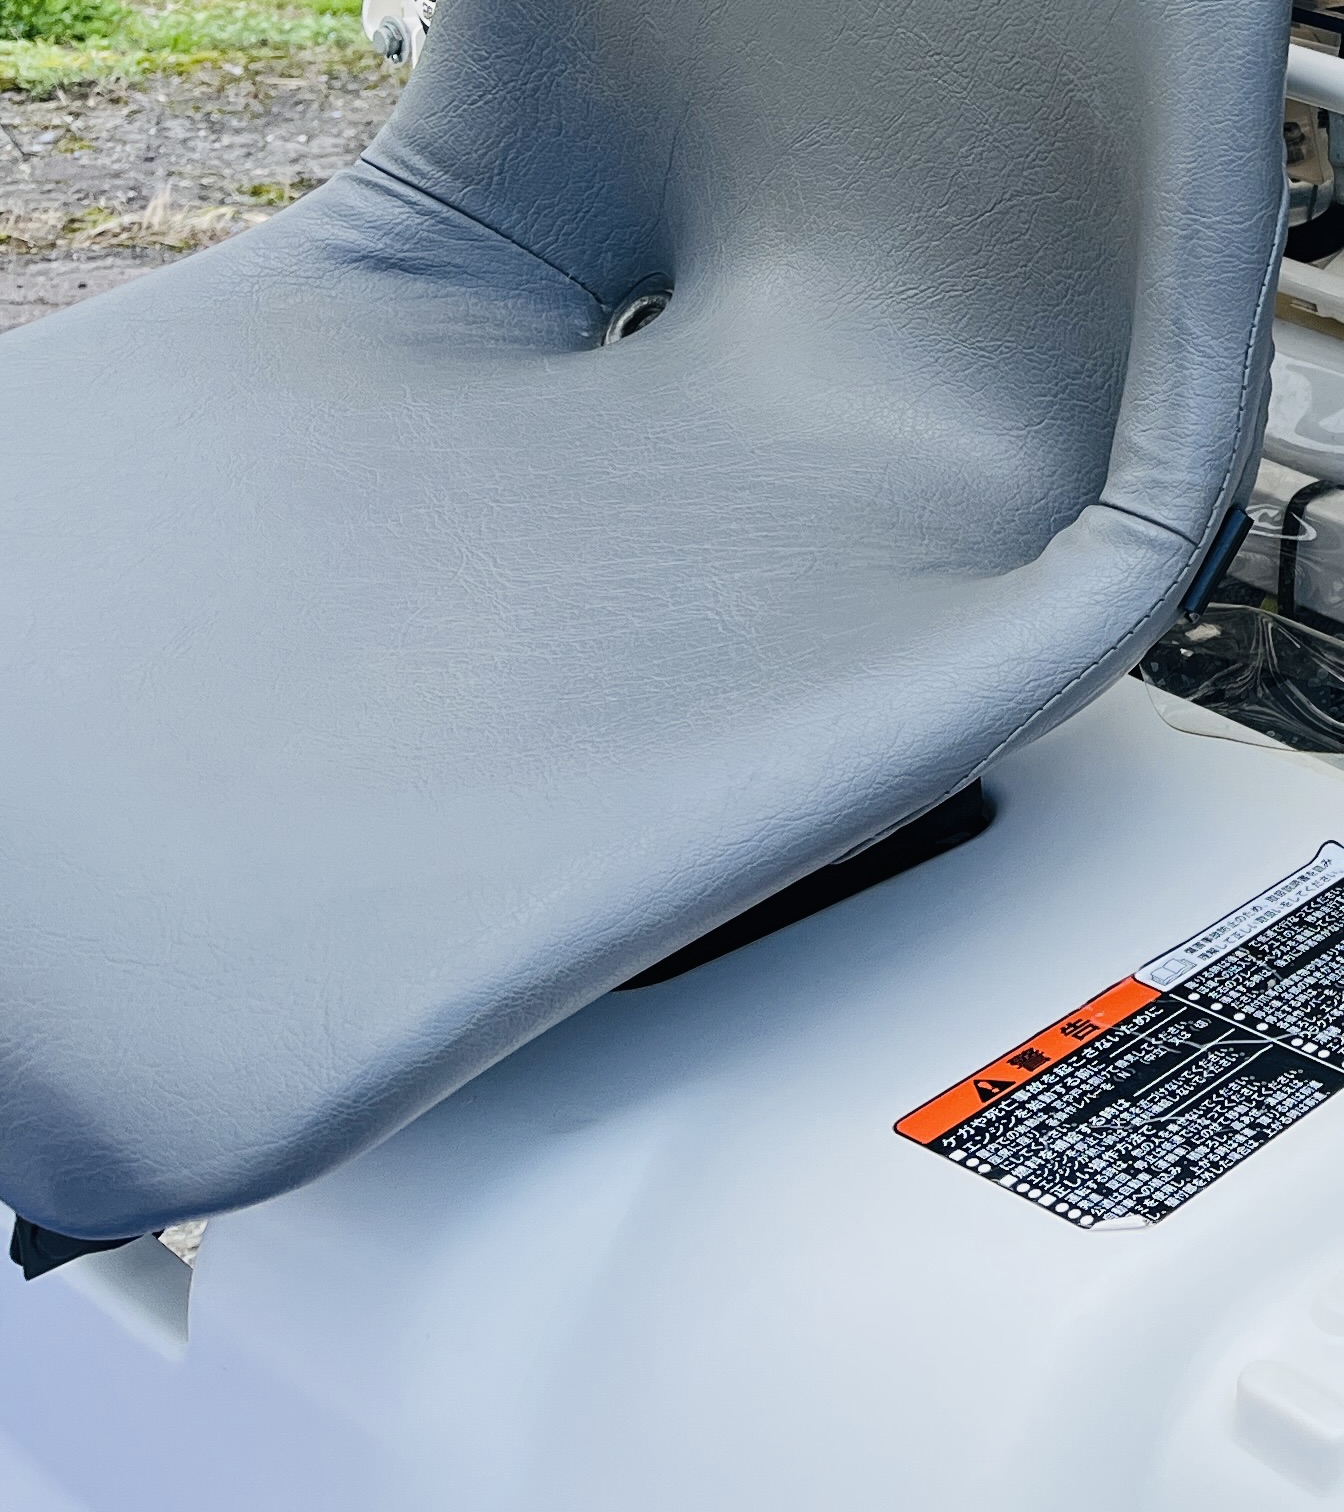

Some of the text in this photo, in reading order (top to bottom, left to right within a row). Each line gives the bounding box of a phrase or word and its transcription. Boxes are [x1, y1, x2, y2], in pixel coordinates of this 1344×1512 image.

[1005, 1013, 1103, 1074] 警告
[960, 1059, 1107, 1153] エンジンを始動する前に
[1047, 1124, 1163, 1197] 正しい操作方法で
